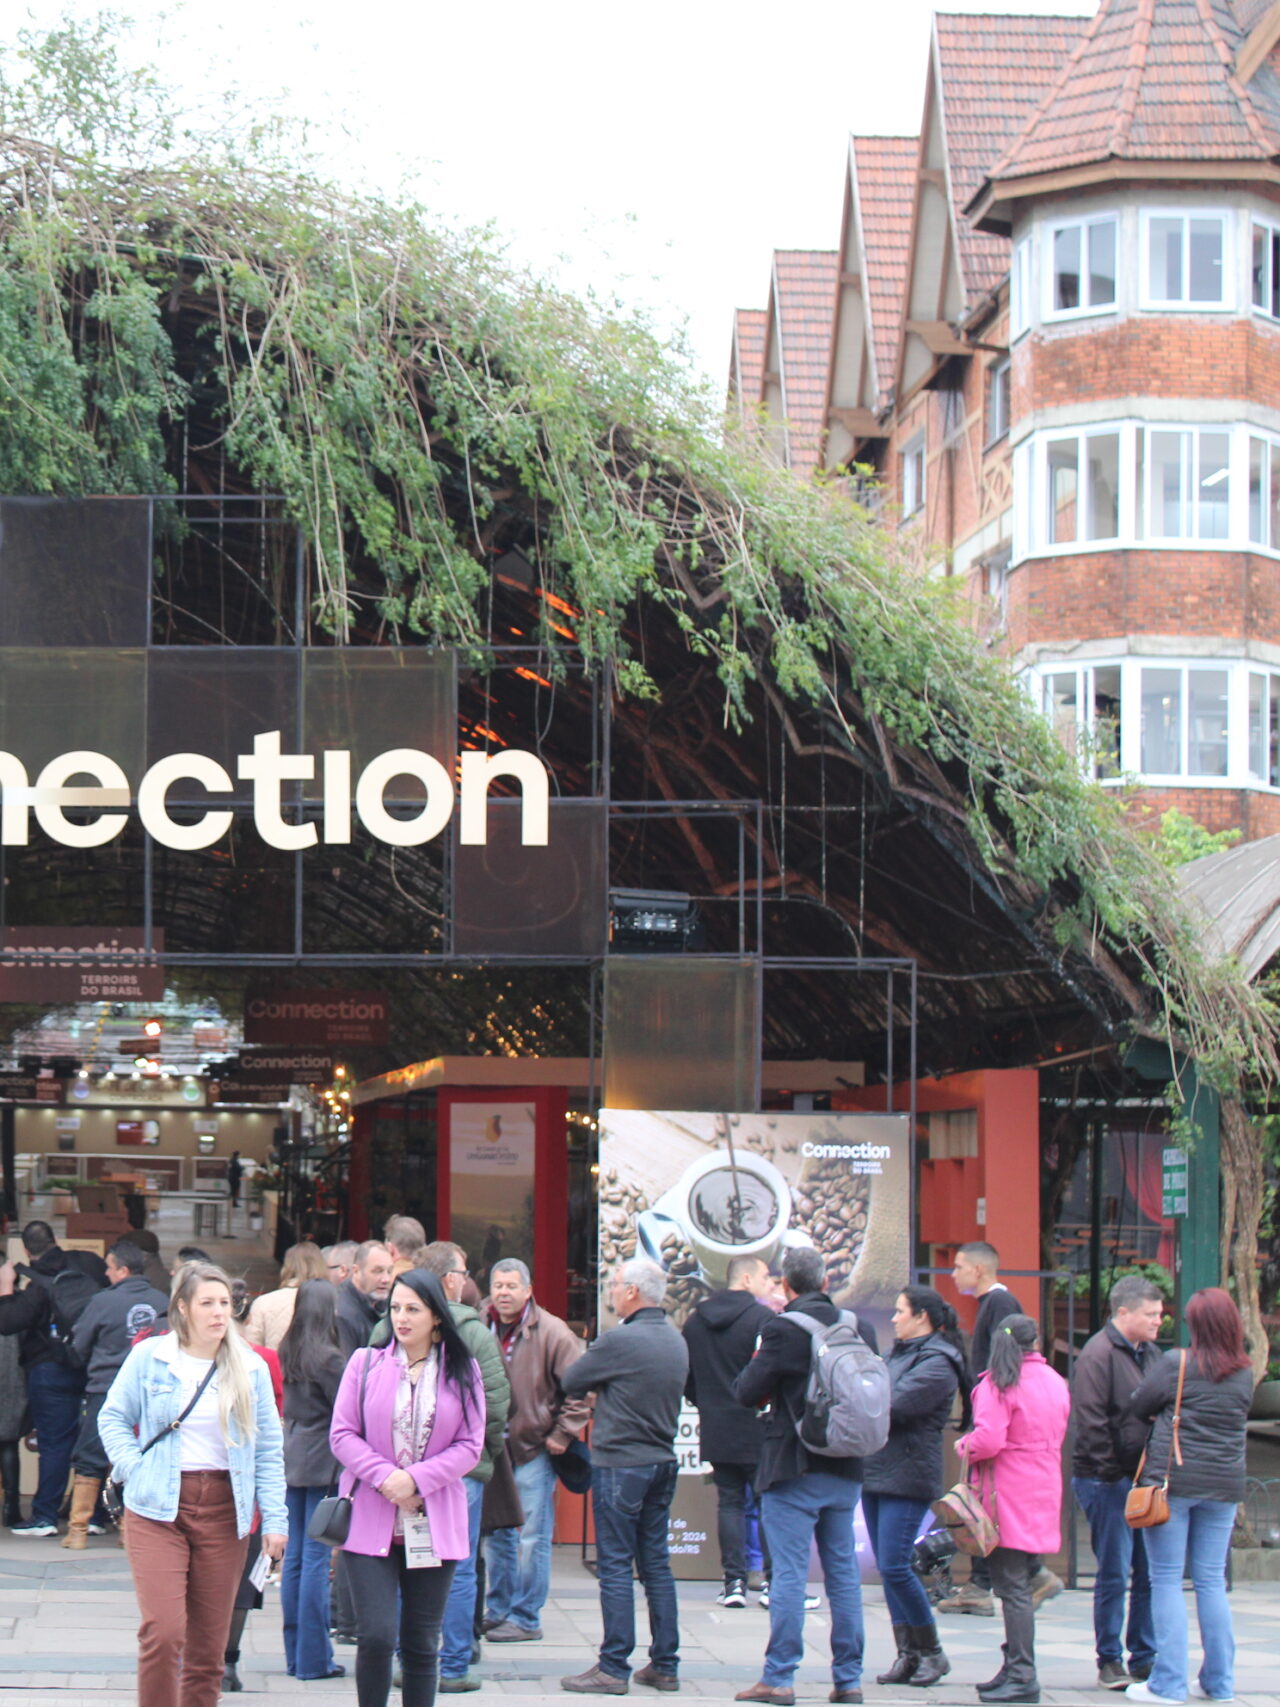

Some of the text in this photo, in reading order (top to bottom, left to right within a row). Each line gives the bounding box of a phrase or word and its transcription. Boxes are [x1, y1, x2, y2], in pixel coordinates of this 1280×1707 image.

[80, 974, 138, 985] TERROIRS
[80, 986, 143, 996] DO BRASIL
[248, 999, 384, 1019] Connection
[240, 1055, 332, 1069] Connection
[801, 1141, 891, 1159] Connection
